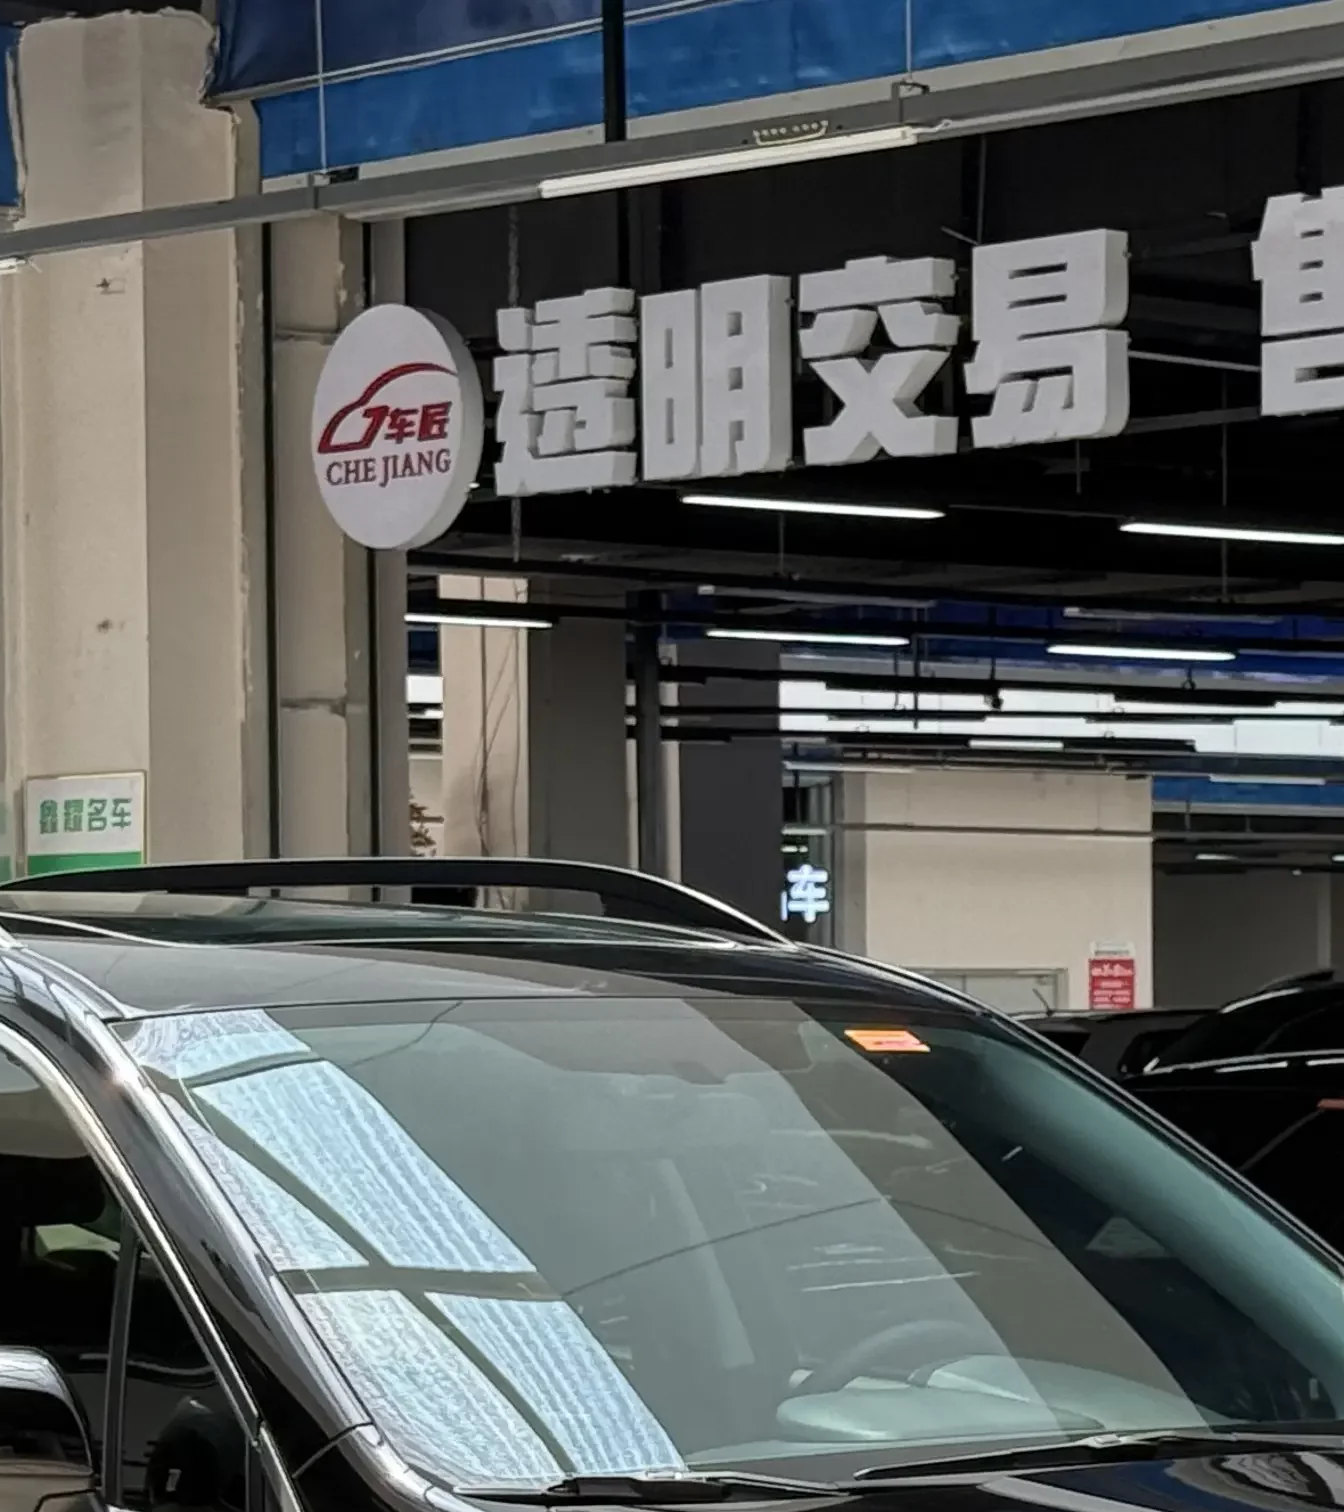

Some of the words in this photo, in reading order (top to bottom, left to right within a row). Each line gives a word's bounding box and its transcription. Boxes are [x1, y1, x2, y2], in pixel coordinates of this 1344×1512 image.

[494, 228, 1129, 497] 透明交易
[384, 401, 452, 444] 车匠
[326, 456, 377, 486] CHE
[380, 449, 452, 488] JIANG
